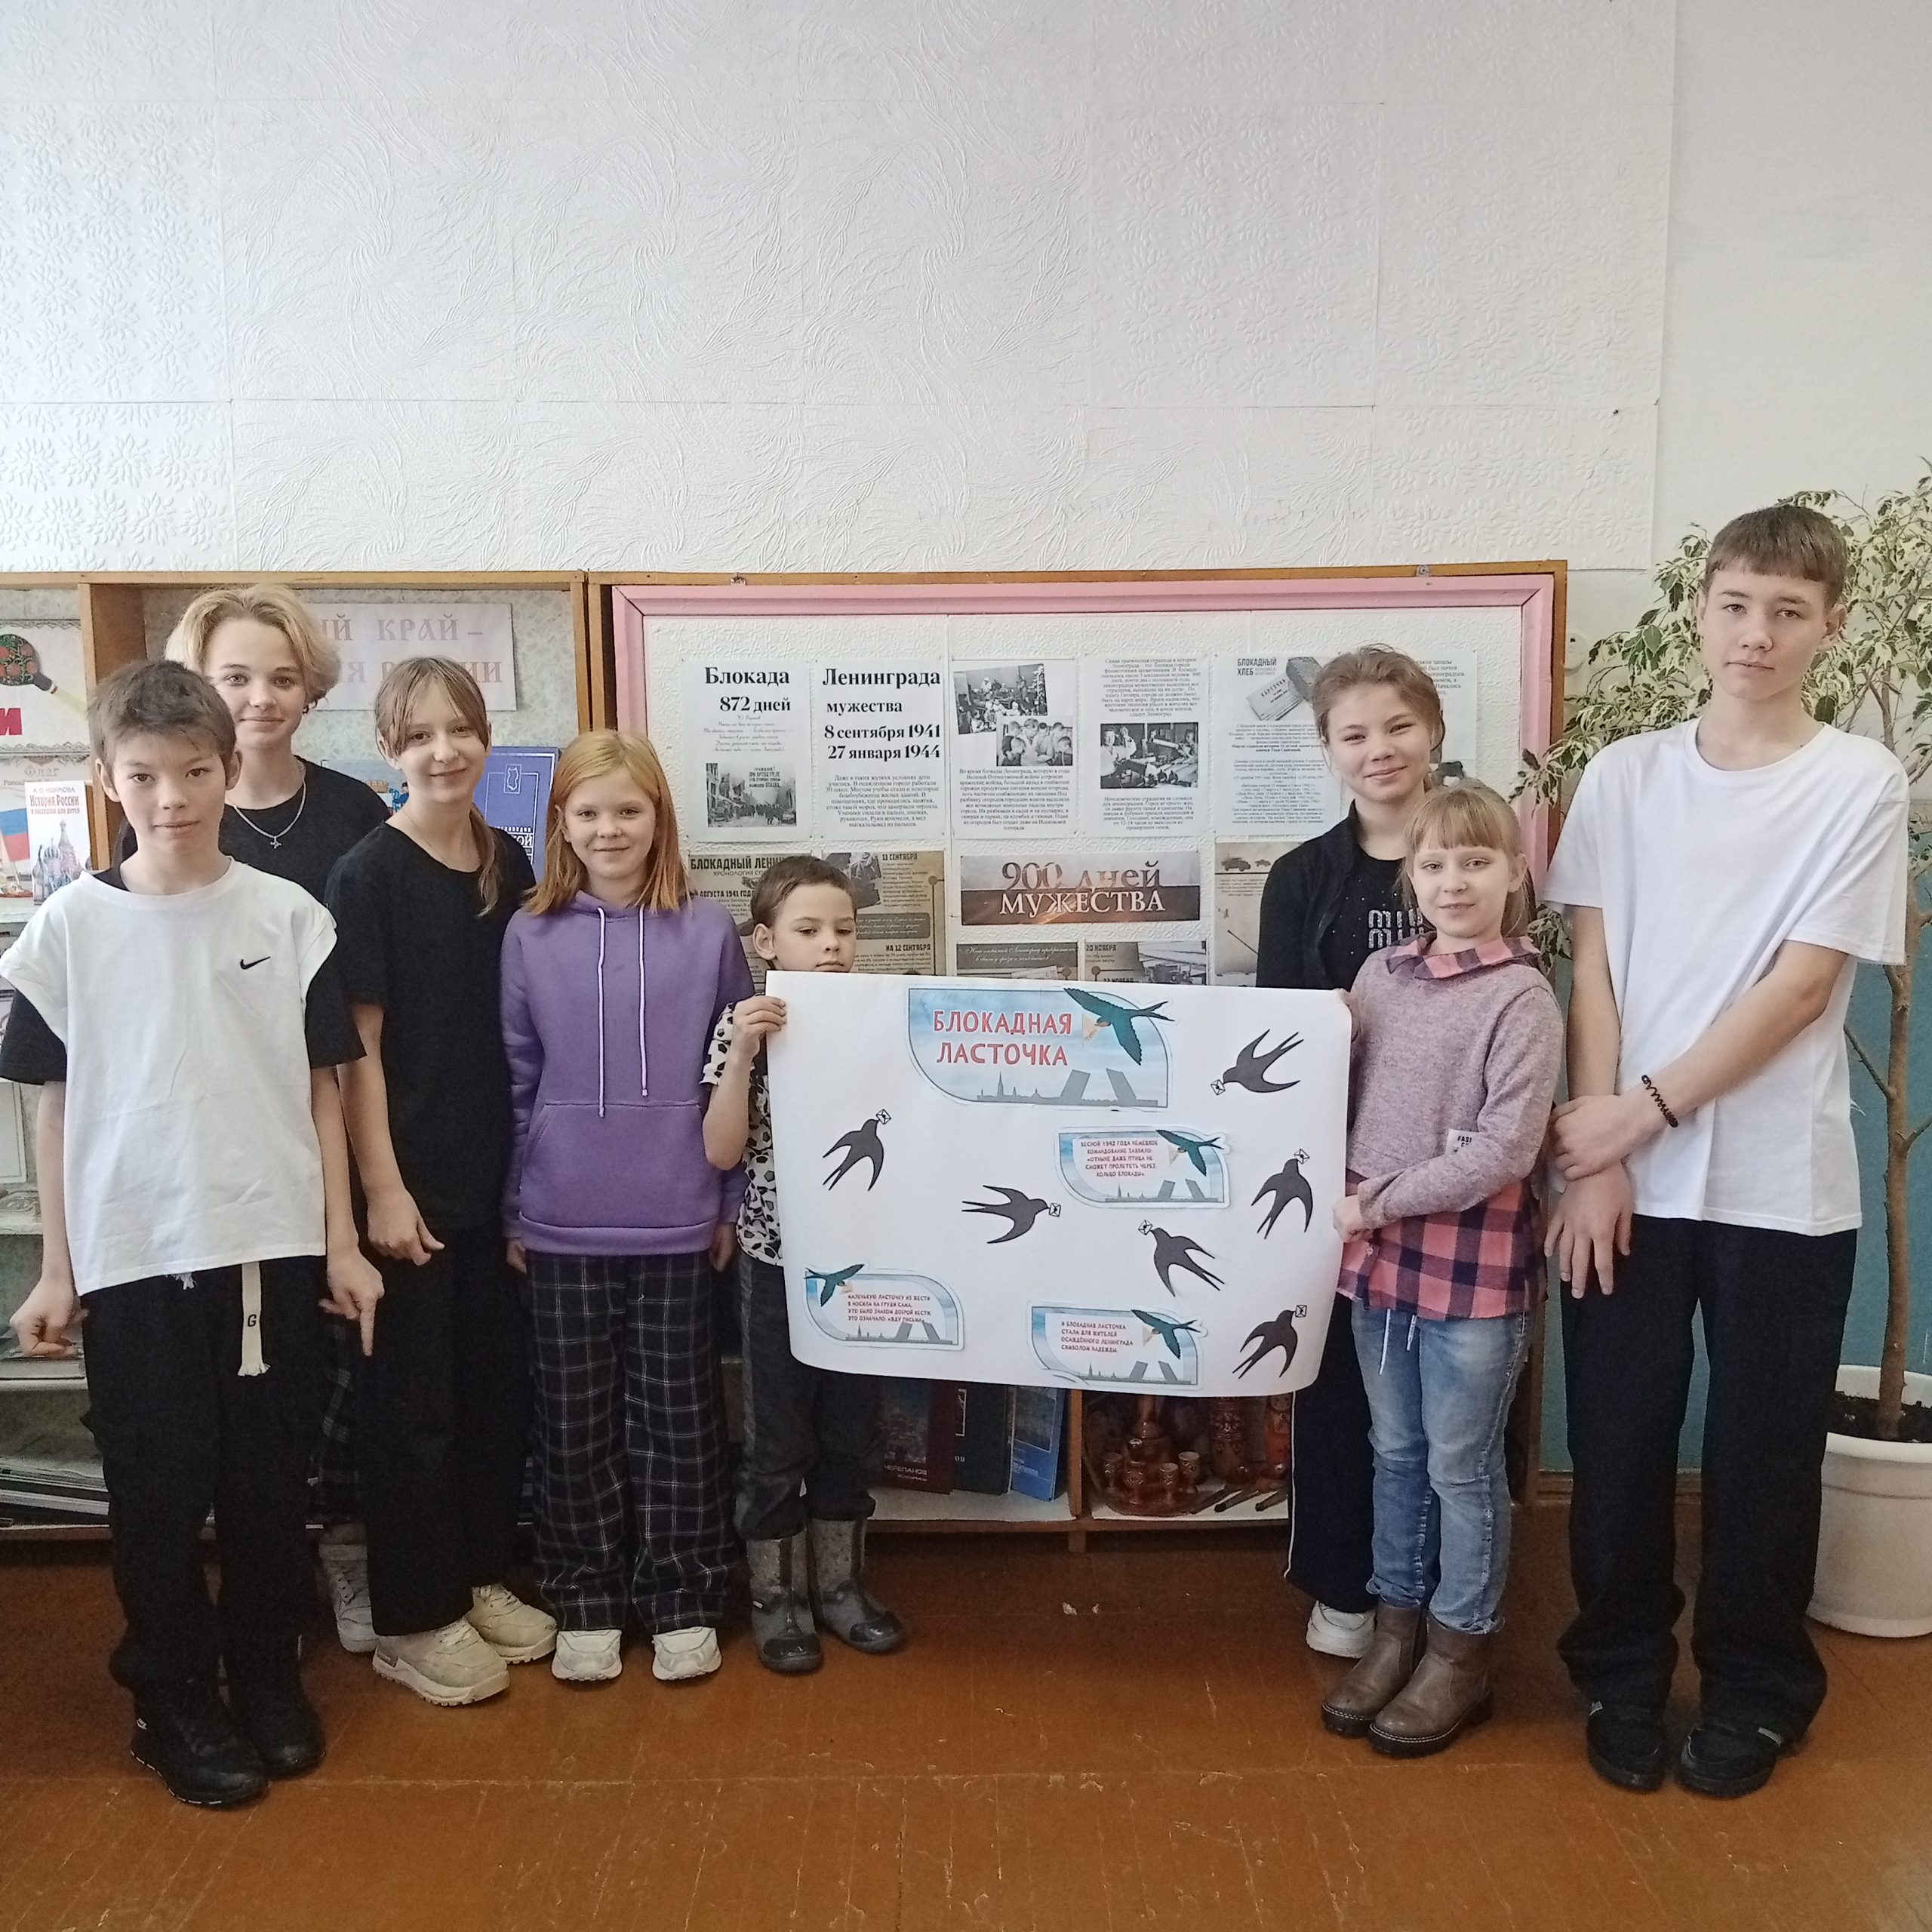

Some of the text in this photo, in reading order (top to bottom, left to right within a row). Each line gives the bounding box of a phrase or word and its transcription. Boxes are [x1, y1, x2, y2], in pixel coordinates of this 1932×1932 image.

[377, 614, 459, 641] КРАЙ
[1238, 657, 1276, 666] БЛОКАДНЫЙ
[705, 667, 789, 688] Блокада
[823, 668, 940, 689] Ленинграда
[720, 696, 791, 714] 872 дней
[826, 702, 903, 716] мужества
[824, 724, 940, 741] 8 сентября 1941
[828, 744, 940, 762] 27 января 1944
[30, 795, 79, 807] История России
[691, 856, 752, 871] БЛОКАДНЫЙ
[1002, 860, 1063, 891] 900
[999, 890, 1165, 918] МУЖЕСТВА
[934, 1011, 1072, 1035] БЛОКАДНАЯ
[937, 1042, 1068, 1066] ЛАСТОЧКА
[247, 1314, 257, 1327] G
[884, 1463, 928, 1475] ЧЕРЕПАНОВ
